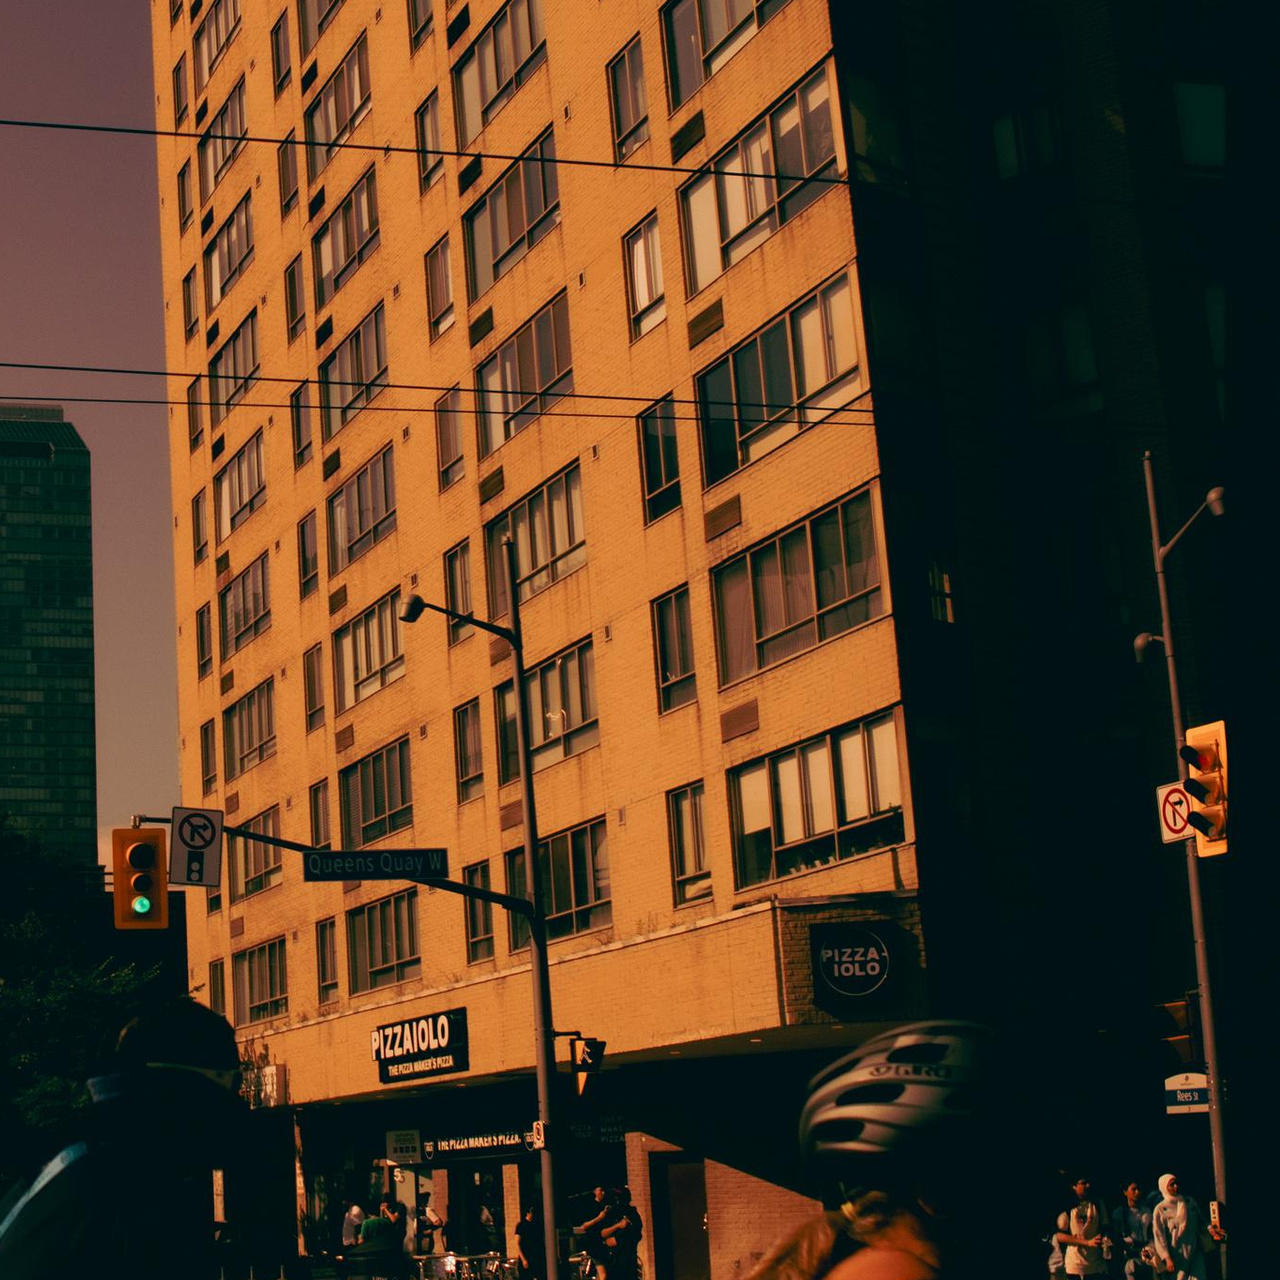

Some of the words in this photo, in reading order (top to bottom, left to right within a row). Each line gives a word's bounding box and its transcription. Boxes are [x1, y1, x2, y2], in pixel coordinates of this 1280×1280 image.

[308, 854, 374, 876] Queens
[380, 852, 424, 876] Quay
[428, 851, 442, 870] W
[833, 961, 880, 977] IOLO
[371, 1014, 449, 1061] PIZZAIOLO
[387, 1064, 399, 1077] THE
[398, 1062, 413, 1075] PIZZA
[413, 1057, 436, 1073] MAKER'S
[437, 1055, 454, 1069] PIZZA
[1176, 1090, 1192, 1102] Rees
